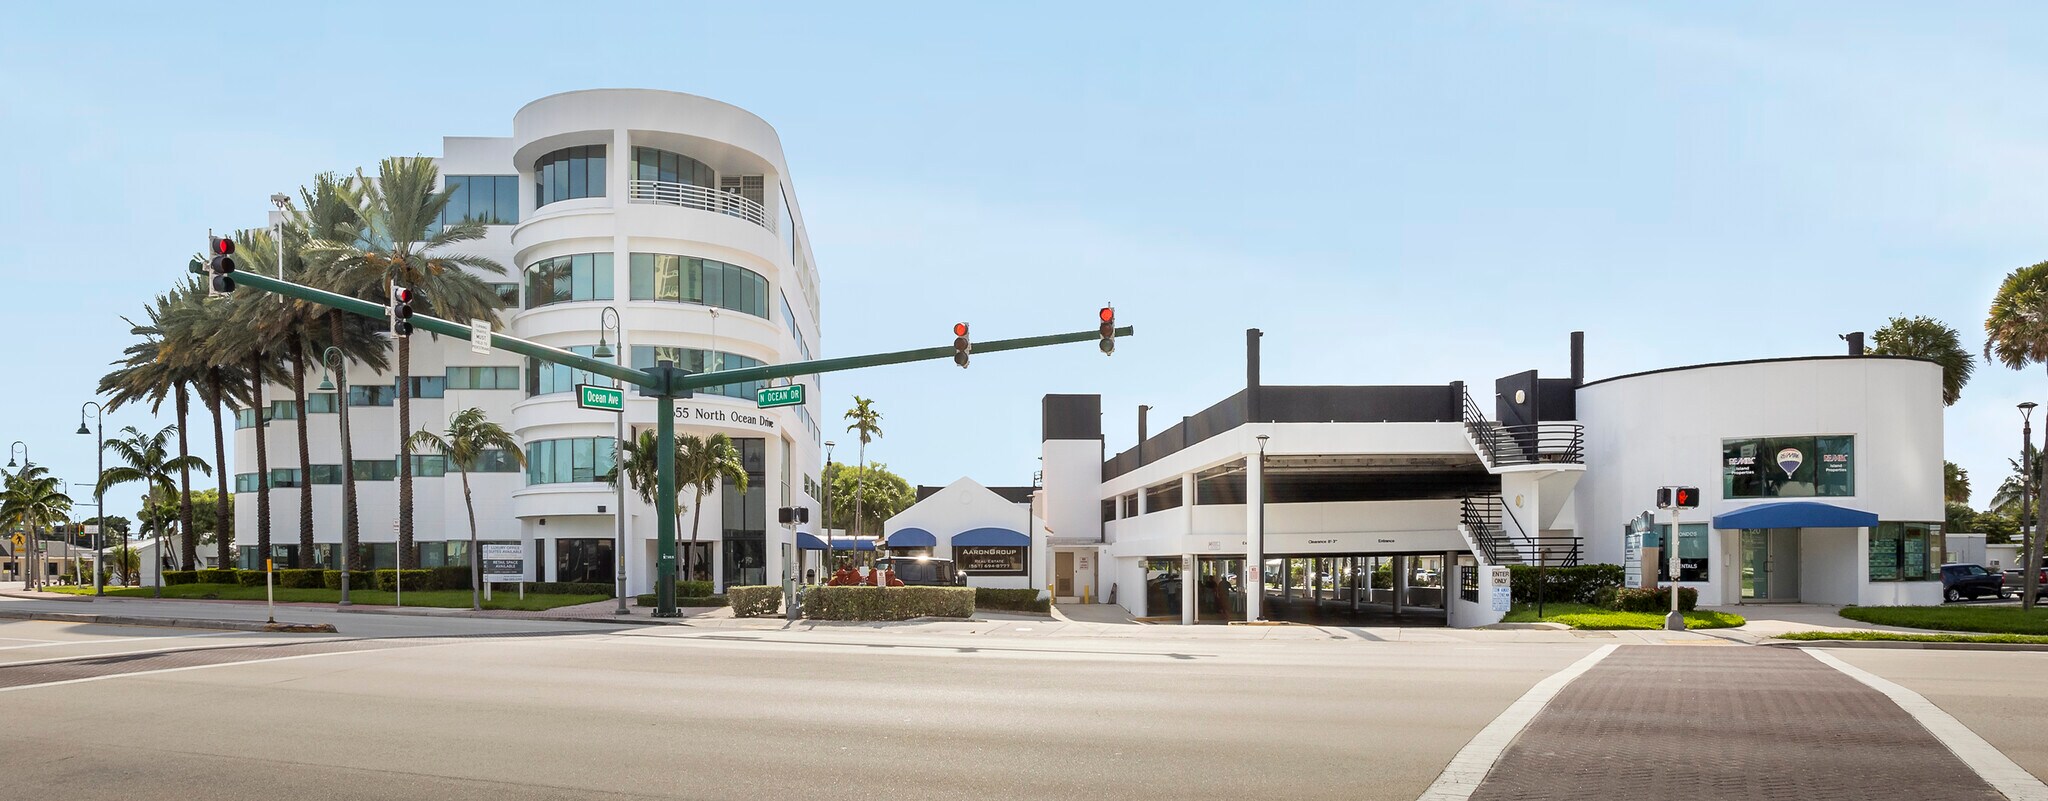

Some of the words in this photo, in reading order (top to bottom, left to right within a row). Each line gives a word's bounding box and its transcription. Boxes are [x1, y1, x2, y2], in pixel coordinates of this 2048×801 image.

[587, 390, 607, 404] Ocean
[608, 393, 619, 405] Ave
[760, 394, 765, 403] N
[767, 391, 788, 402] OCEAN
[790, 389, 800, 399] DR
[695, 408, 726, 421] North
[730, 410, 757, 425] Ocean
[759, 415, 773, 427] Drive
